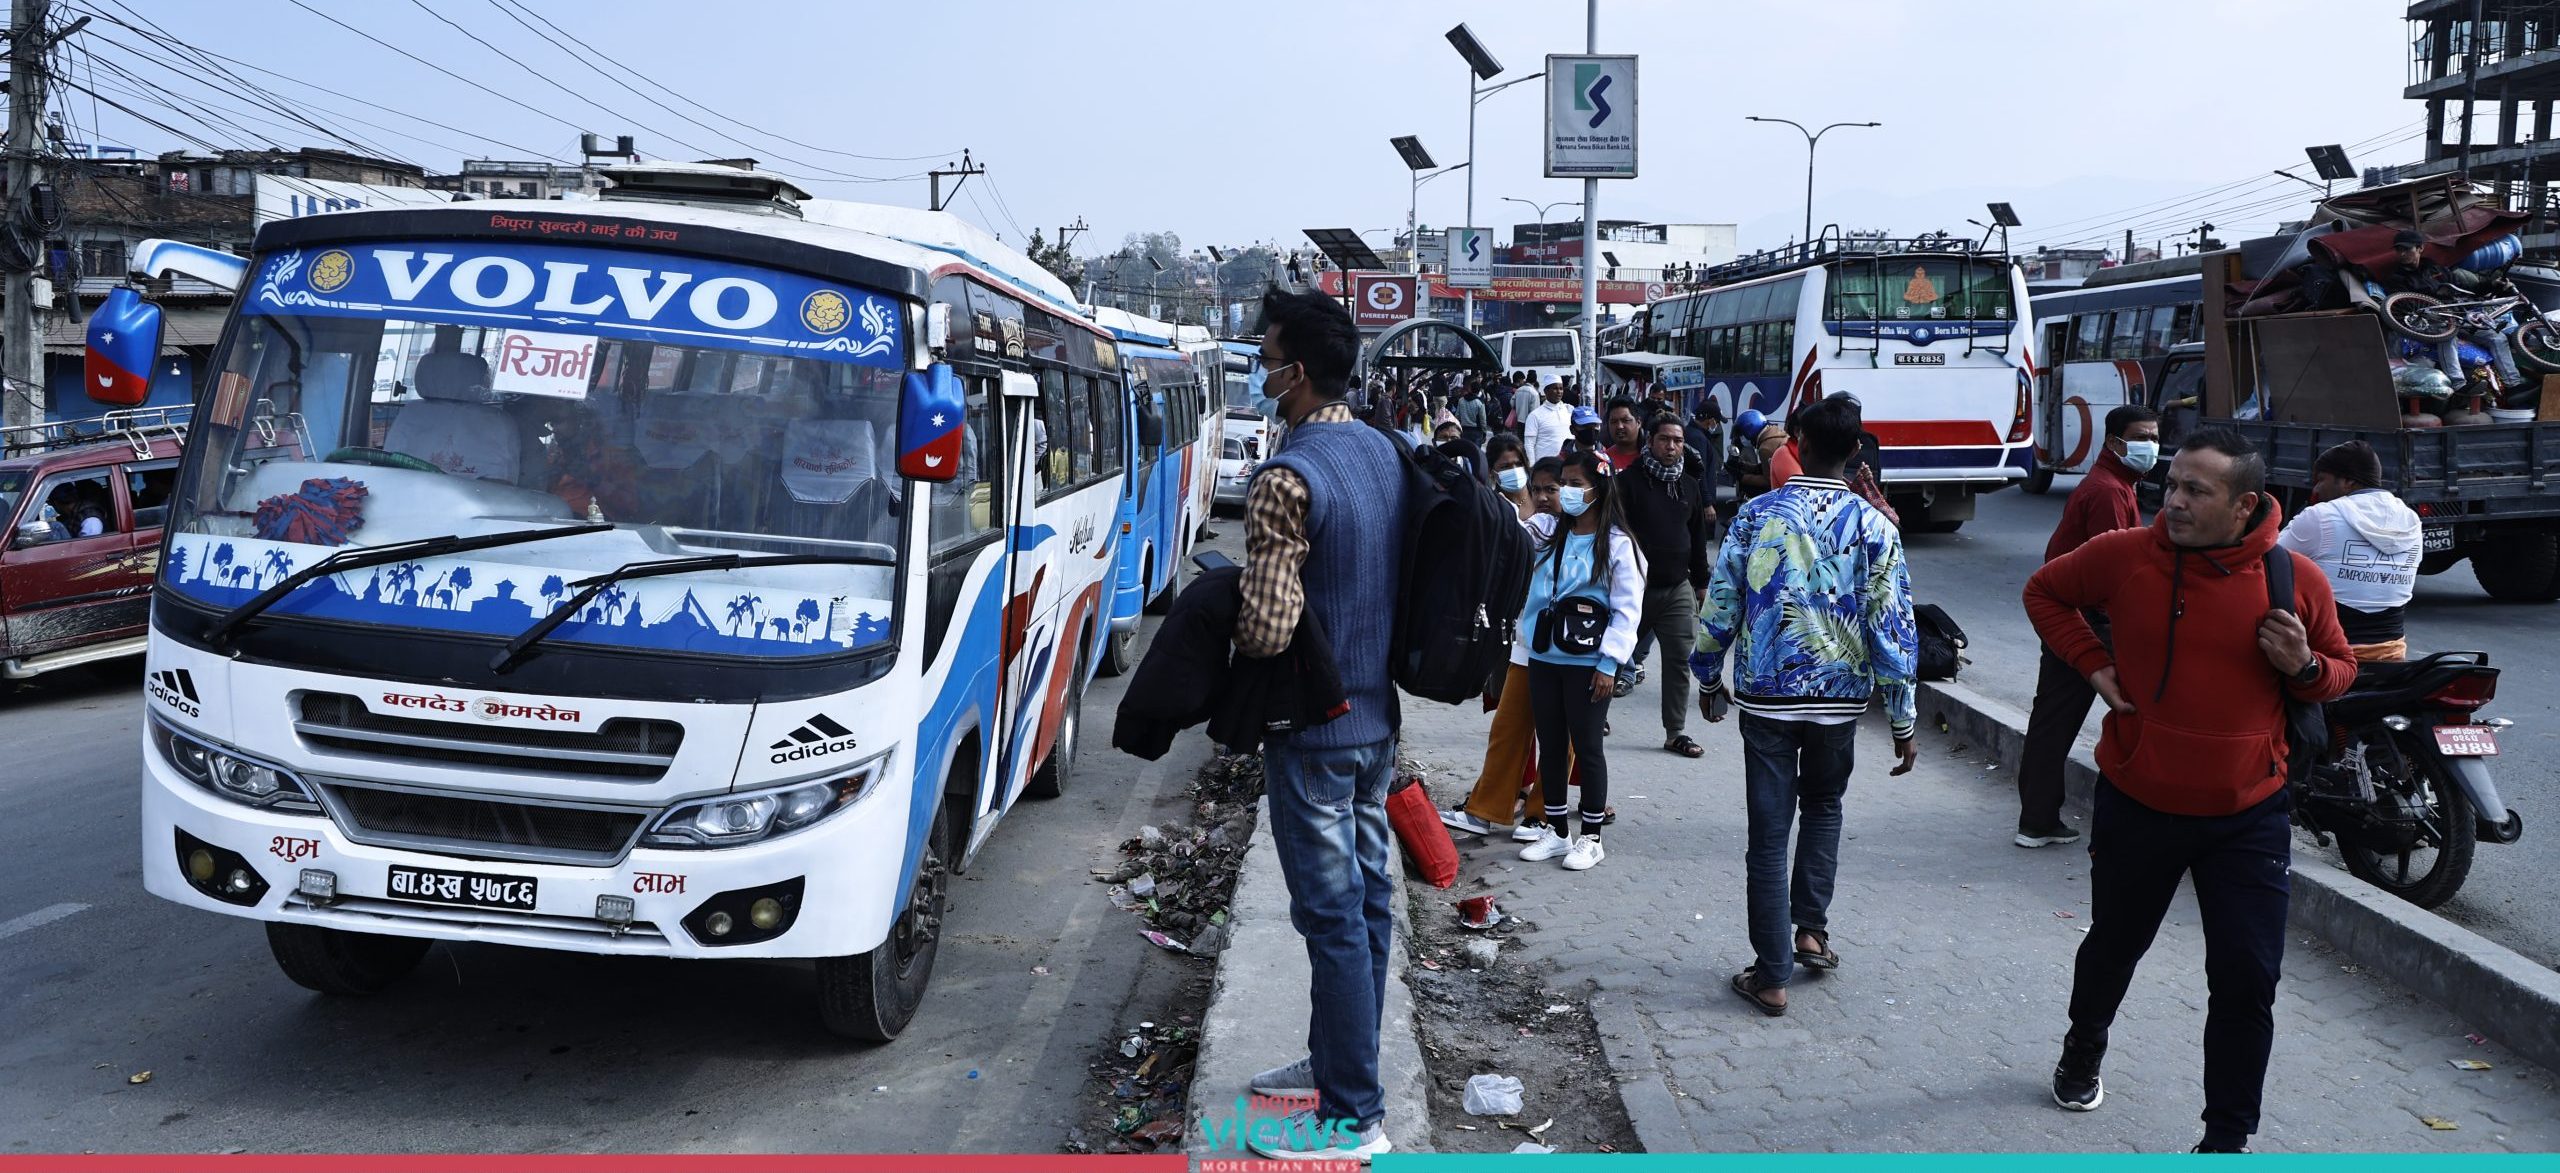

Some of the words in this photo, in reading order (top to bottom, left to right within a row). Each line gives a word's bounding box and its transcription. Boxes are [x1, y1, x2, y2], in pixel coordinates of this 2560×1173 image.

[490, 214, 532, 232] त्रिपुरा
[538, 219, 586, 234] सुन्दरी
[624, 226, 644, 239] की
[650, 228, 679, 241] जय
[373, 249, 778, 329] VOLVO
[1896, 326, 1910, 335] Was
[1934, 326, 1951, 335] Born
[1951, 326, 1959, 335] In
[500, 334, 592, 380] रिजर्भ
[1682, 364, 1701, 372] CREAM
[2337, 567, 2379, 583] EMPORIO
[148, 680, 200, 718] adidas
[383, 693, 469, 712] बलदेउ
[770, 737, 857, 764] adidas
[2440, 742, 2497, 755] ४५४५
[270, 836, 320, 862] शुभ
[470, 878, 533, 905] ५७८६
[633, 871, 687, 894] लाभ
